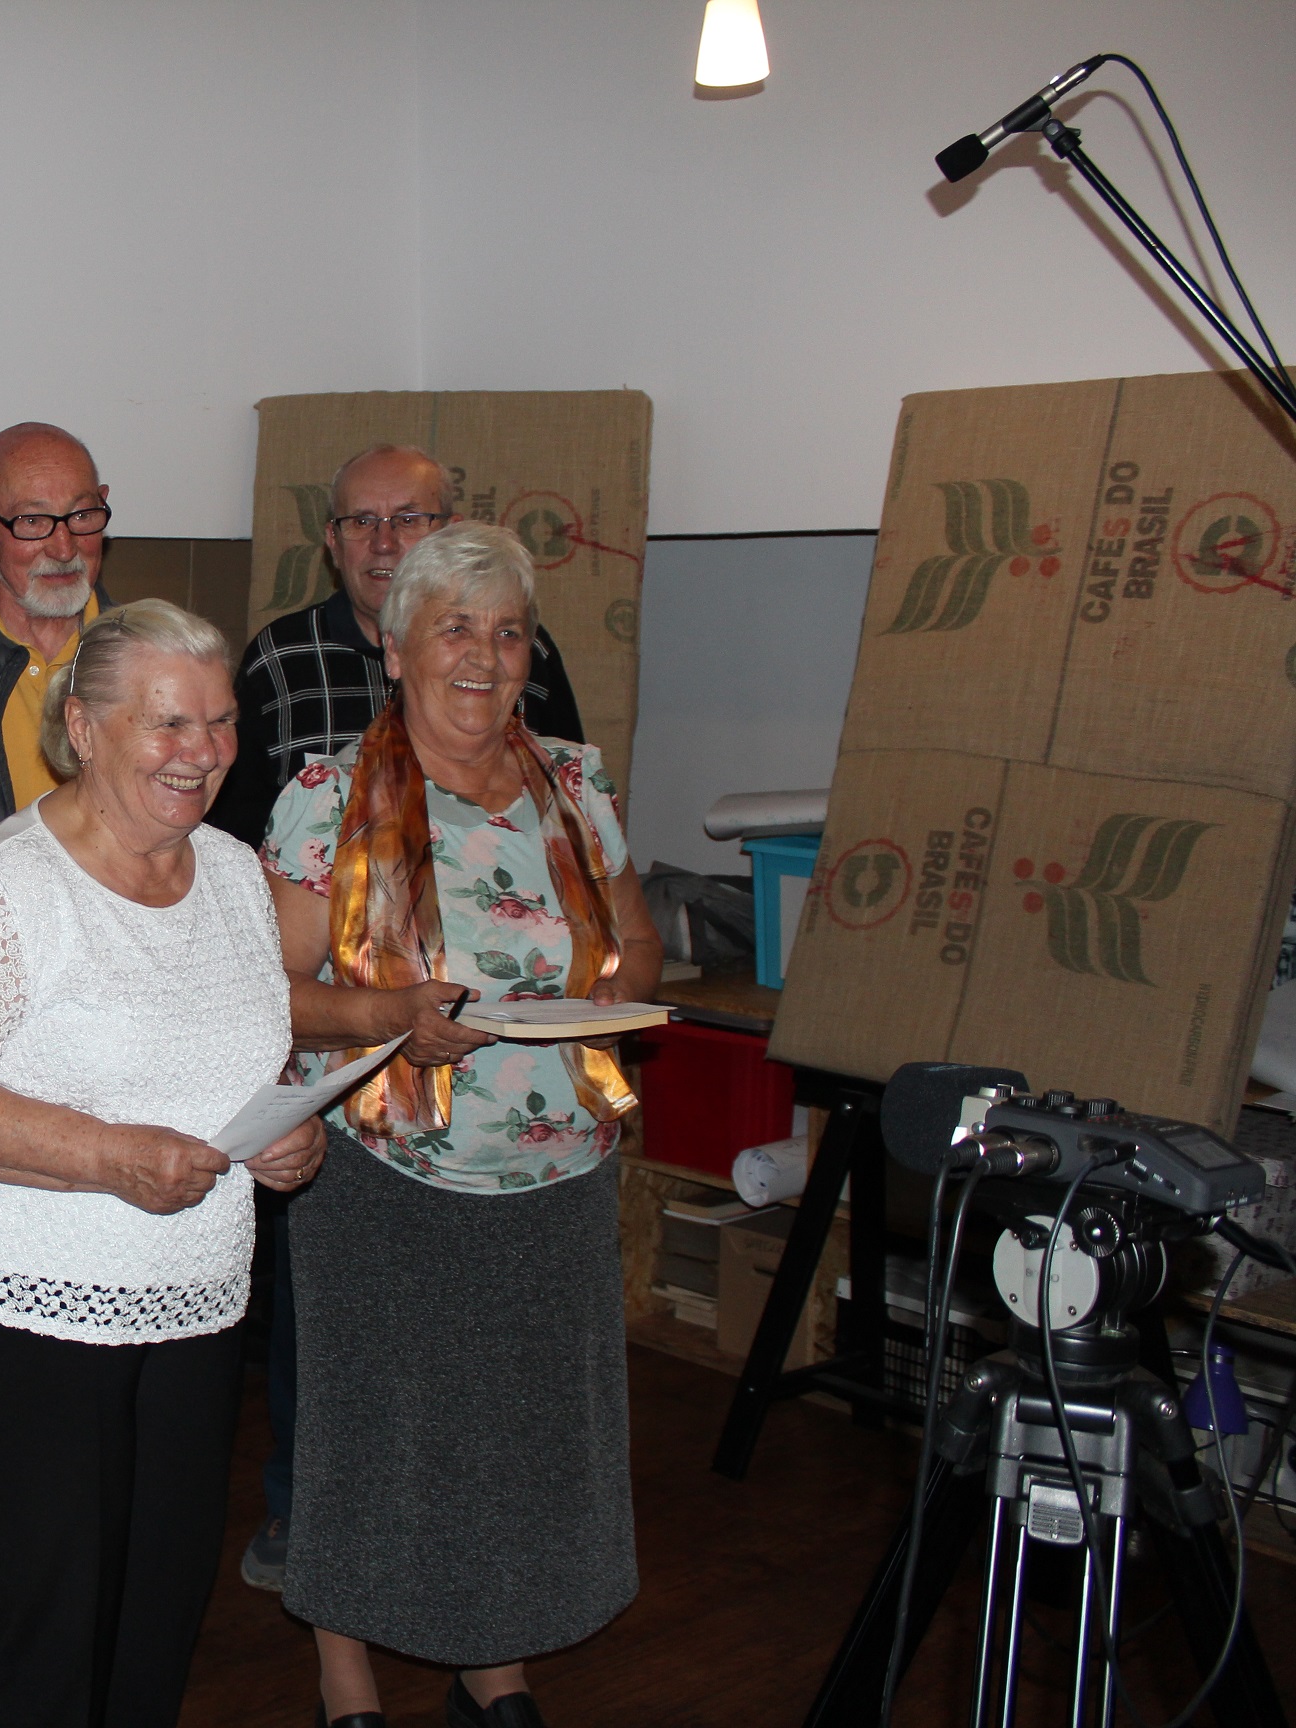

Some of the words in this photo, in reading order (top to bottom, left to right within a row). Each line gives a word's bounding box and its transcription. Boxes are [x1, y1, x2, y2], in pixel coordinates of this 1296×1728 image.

[1105, 461, 1141, 504] DO
[1122, 487, 1174, 598] BRASIL
[910, 830, 954, 936] BRASIL
[939, 921, 972, 966] DO
